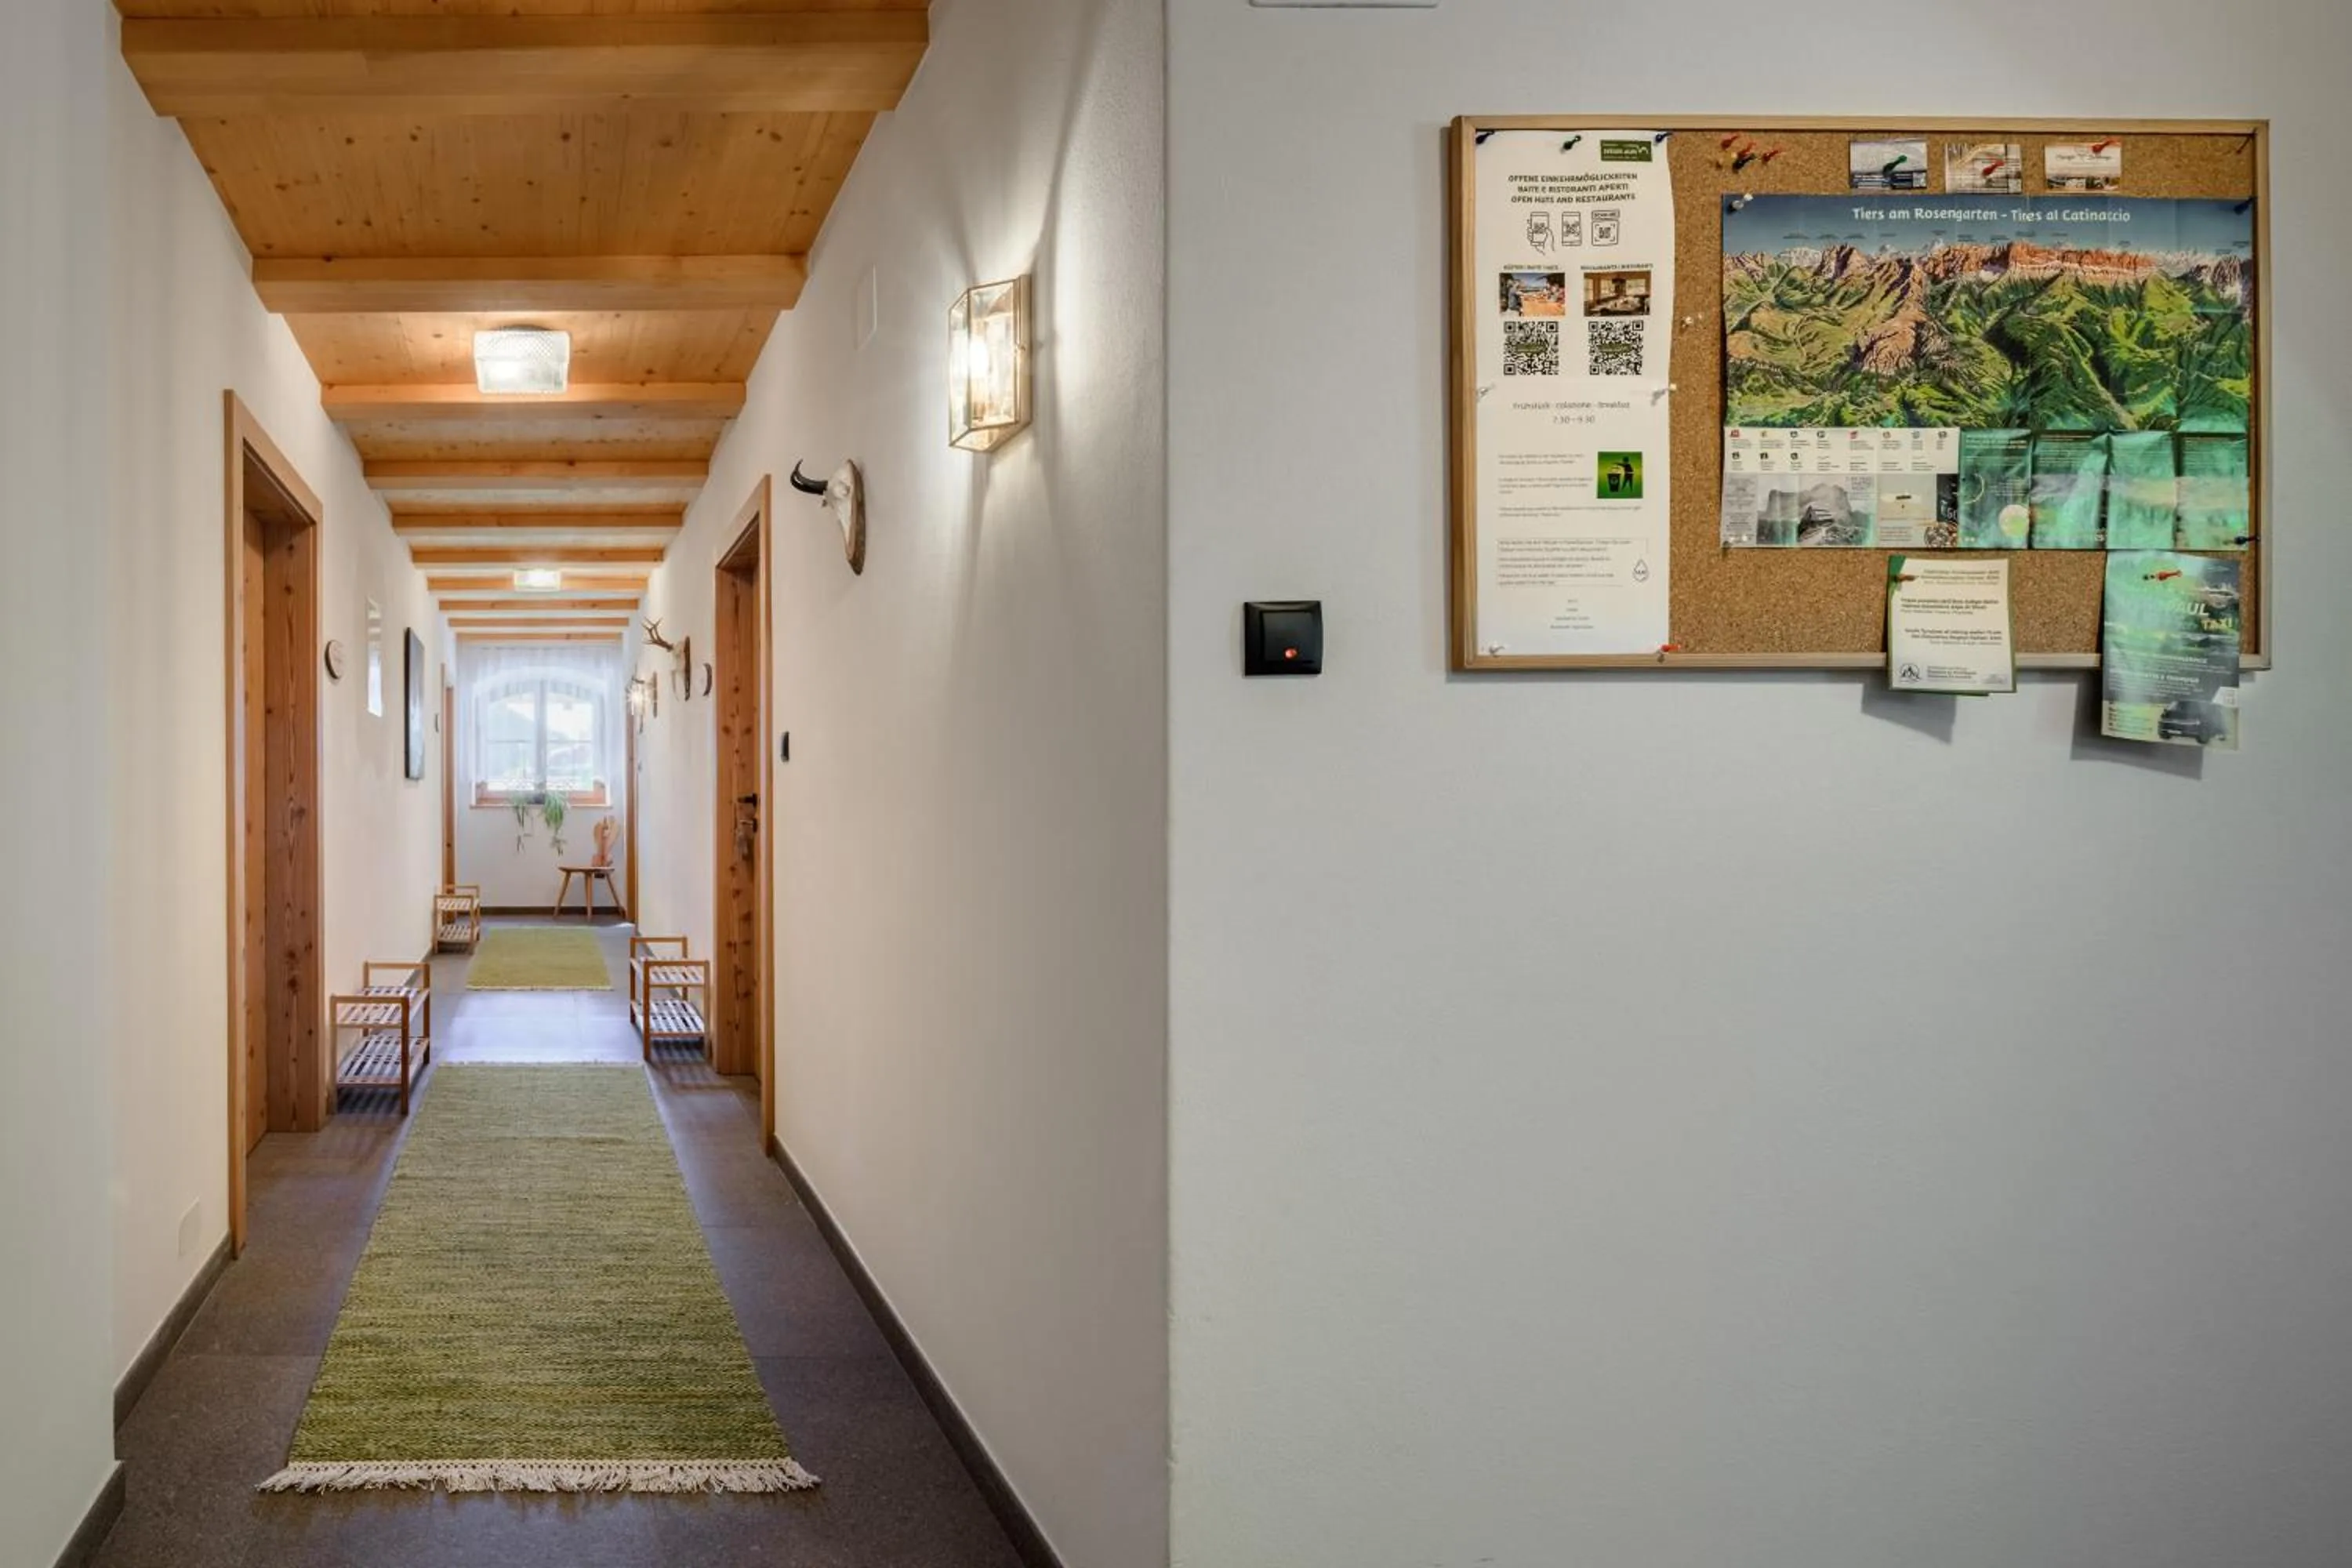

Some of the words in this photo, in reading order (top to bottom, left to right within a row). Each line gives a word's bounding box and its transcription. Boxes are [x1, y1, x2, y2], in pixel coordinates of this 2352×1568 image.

[1852, 207, 1885, 220] Tiers
[1889, 209, 1911, 220] am
[1914, 207, 1998, 222] Rosengarten
[2045, 209, 2059, 220] al
[2062, 208, 2131, 222] Catinaccio
